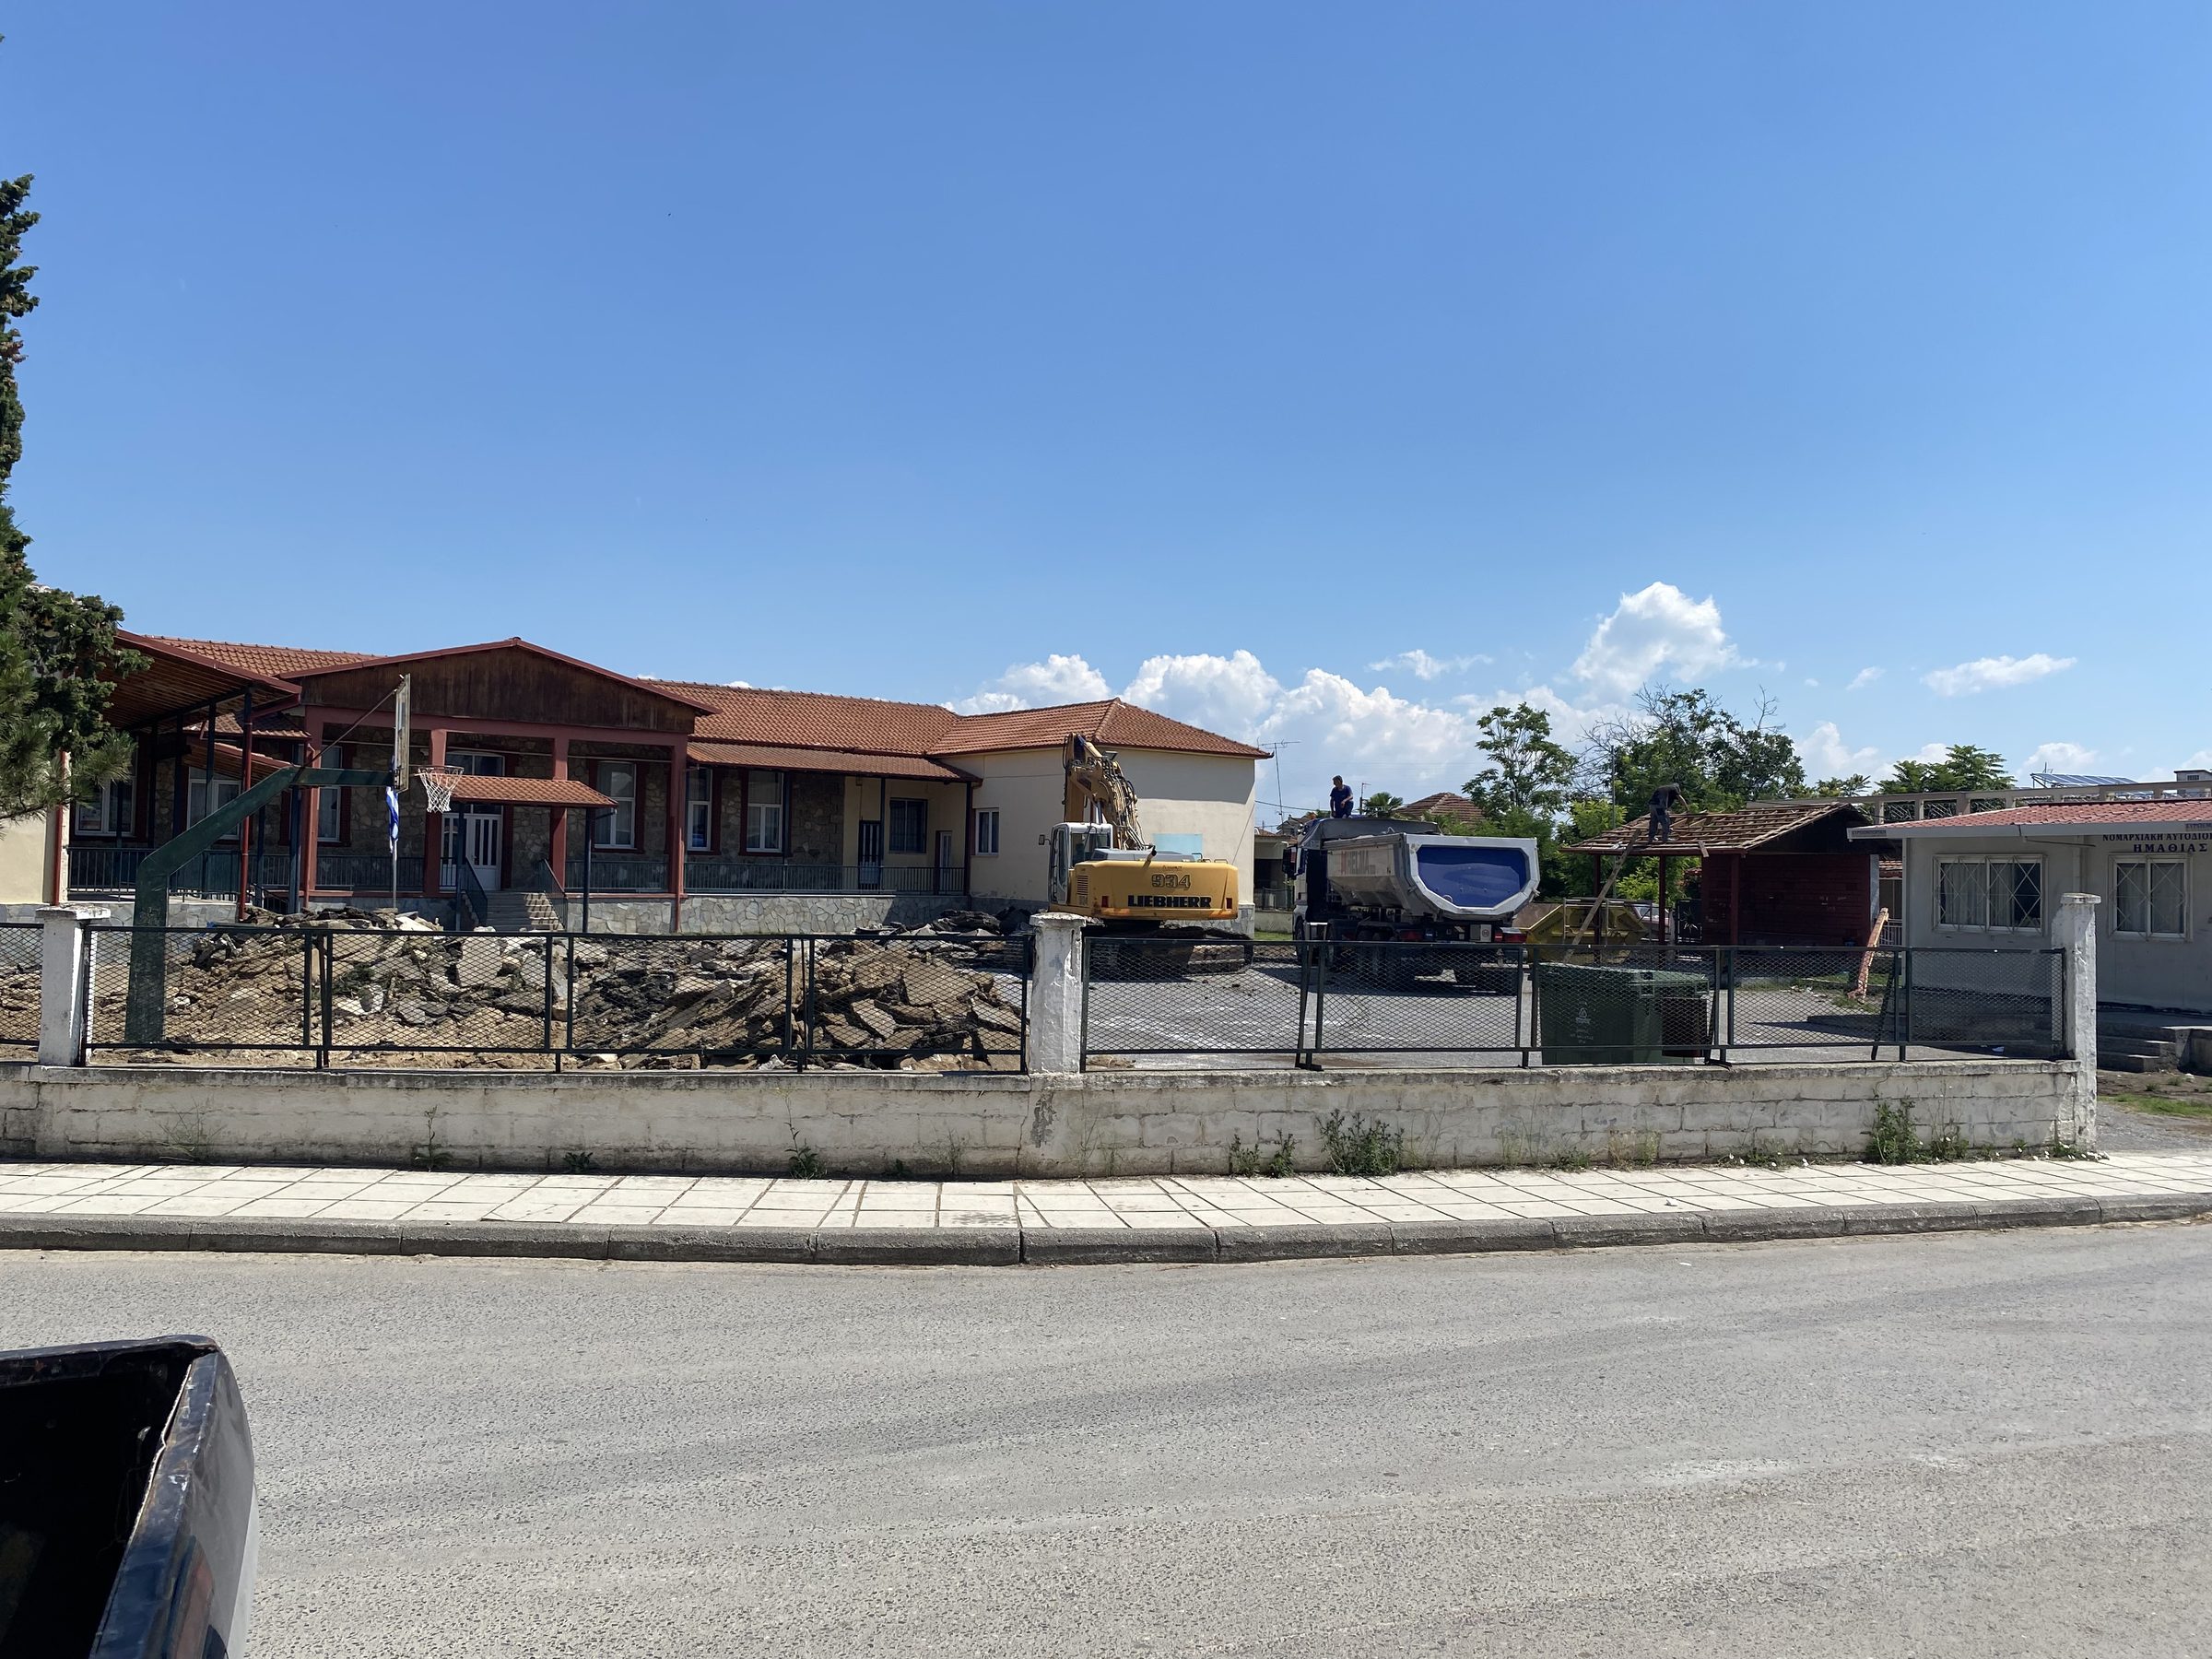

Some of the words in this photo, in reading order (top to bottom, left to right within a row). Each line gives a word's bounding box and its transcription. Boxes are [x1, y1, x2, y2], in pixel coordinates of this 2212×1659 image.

[2102, 833, 2163, 841] ΝΟΜΑΡΧΙΑΚΗ
[2134, 843, 2207, 853] ΗΜΑΘΙΑΣ
[1151, 873, 1192, 889] 934
[1127, 895, 1212, 909] LIEBHERR
